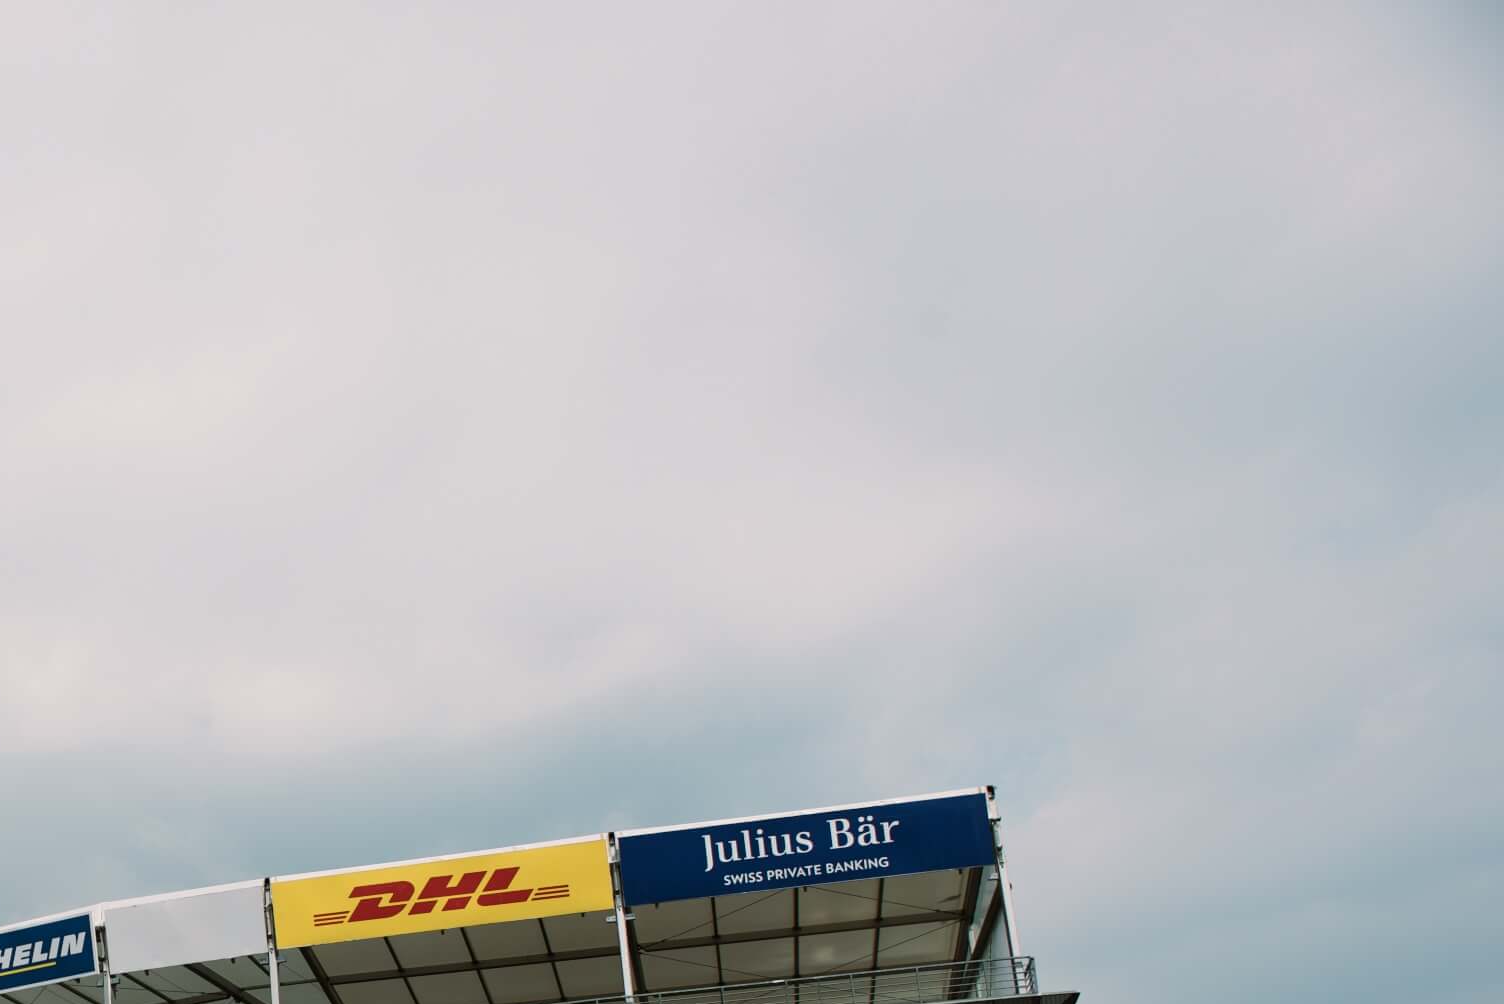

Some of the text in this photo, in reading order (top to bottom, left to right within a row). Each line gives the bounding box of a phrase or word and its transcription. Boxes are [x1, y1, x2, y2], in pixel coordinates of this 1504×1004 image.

[702, 815, 900, 873] Julius Bär
[723, 856, 889, 886] SWISS PRIVATE BANKING
[347, 866, 534, 923] DHL
